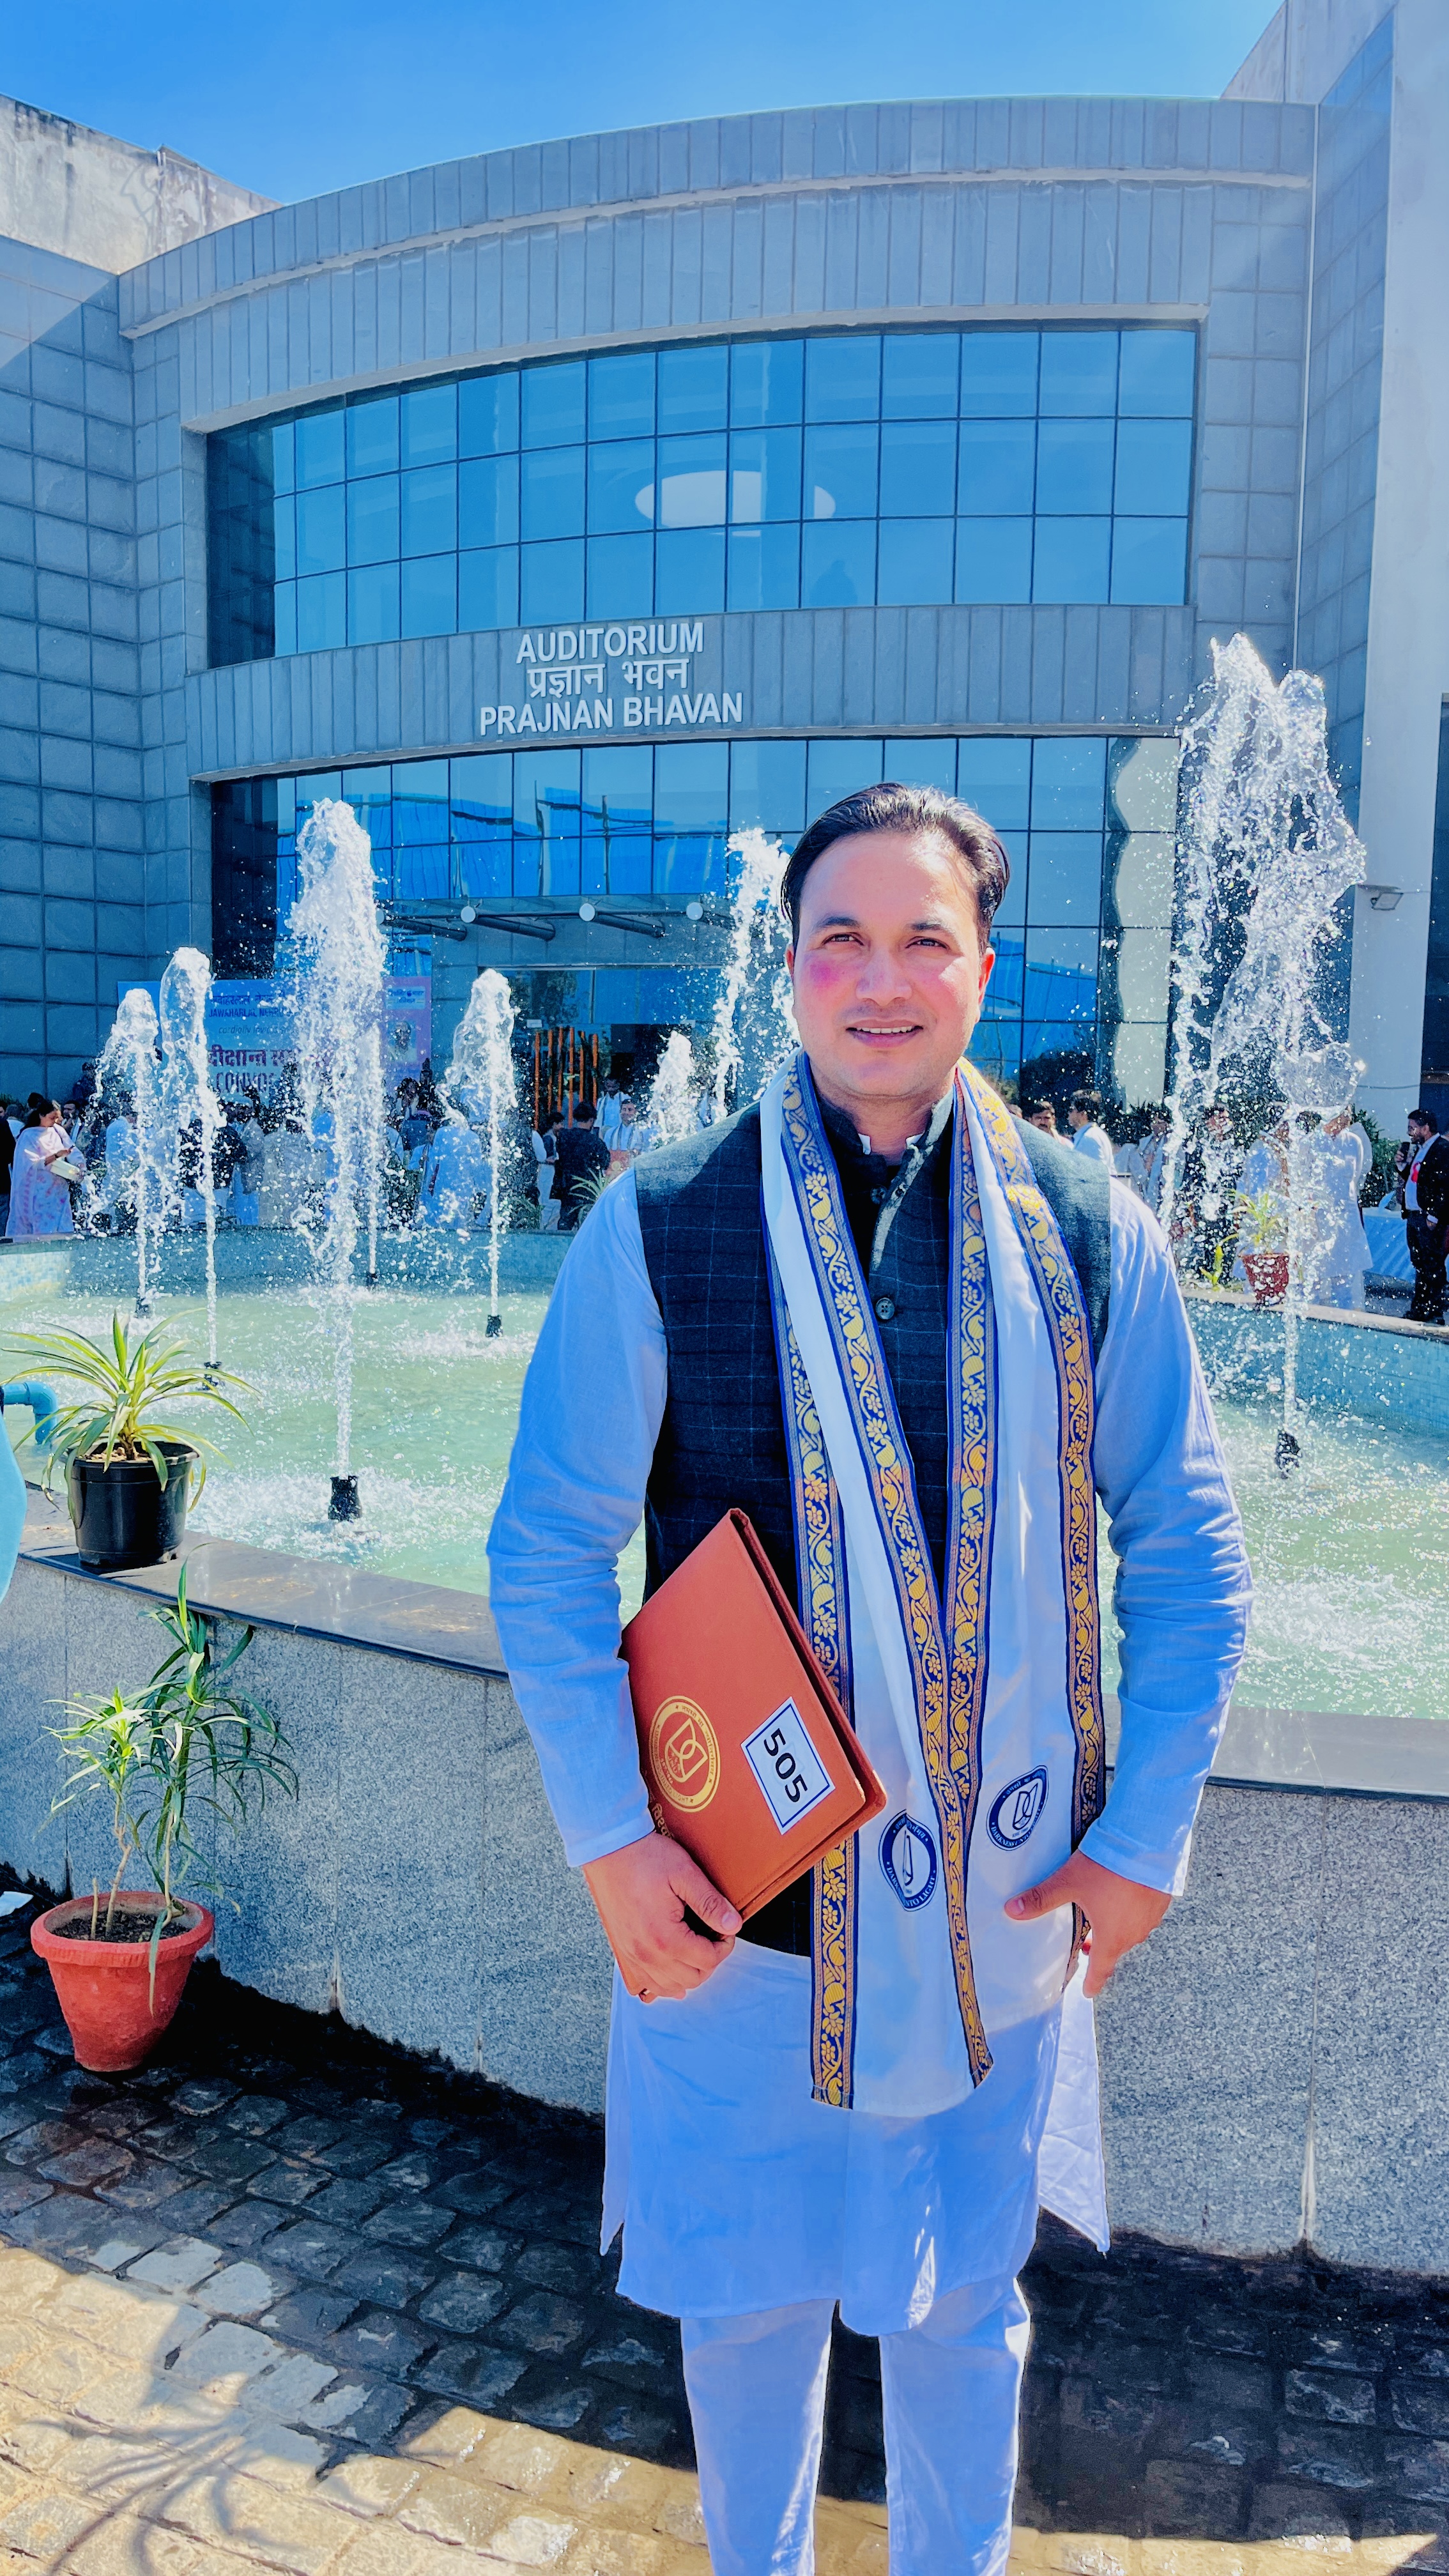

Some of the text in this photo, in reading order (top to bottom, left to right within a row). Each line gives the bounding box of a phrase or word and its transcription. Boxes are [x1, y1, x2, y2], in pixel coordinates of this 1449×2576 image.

[516, 622, 703, 664] AUDITORIUM
[527, 658, 689, 699] प्रज्ञान भवन
[480, 692, 743, 737] PRAJNAN BHAVAN
[763, 1727, 808, 1804] 505
